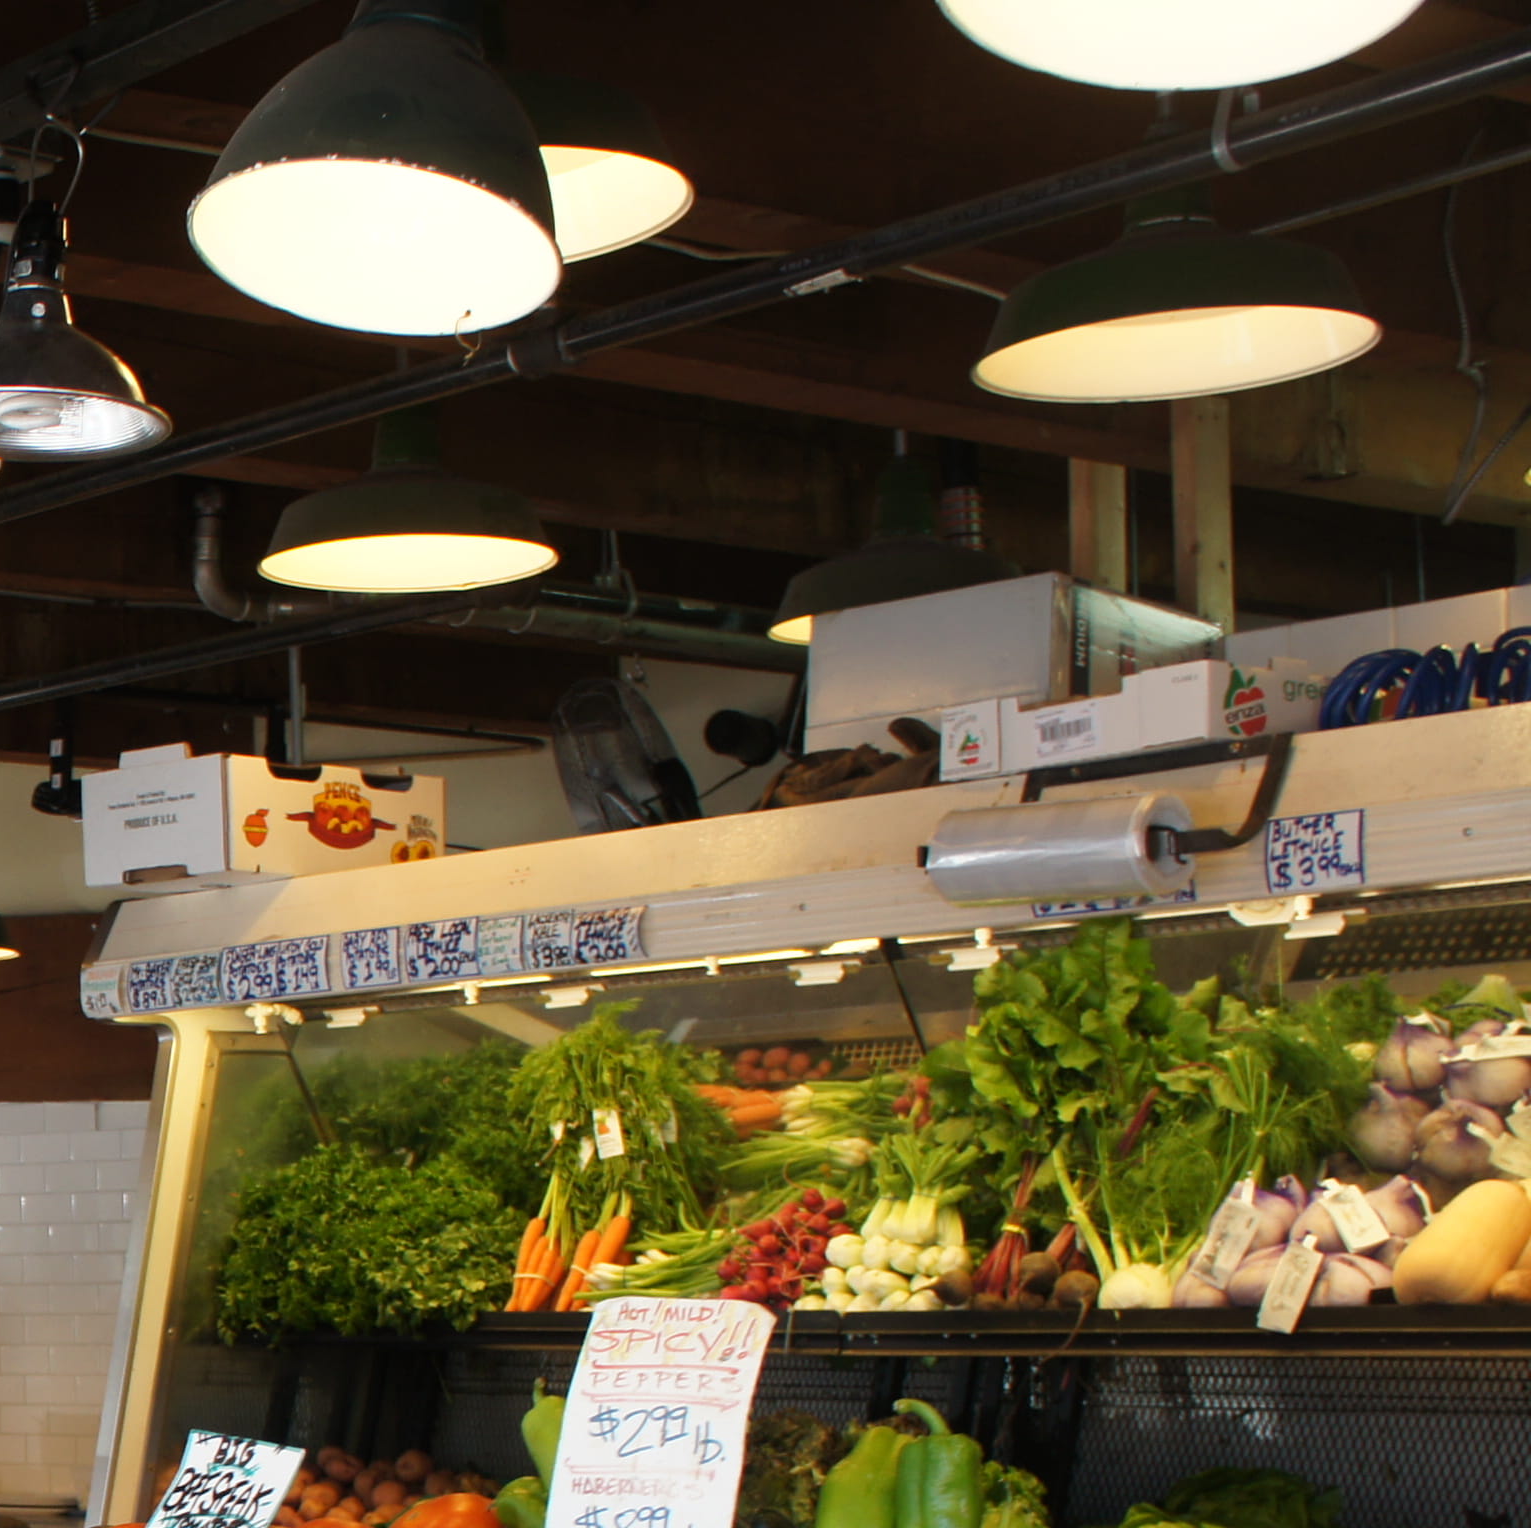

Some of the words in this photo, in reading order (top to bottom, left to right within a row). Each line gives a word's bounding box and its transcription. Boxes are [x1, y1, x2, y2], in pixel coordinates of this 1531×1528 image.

[1272, 813, 1335, 843] BUTTER
[1270, 831, 1344, 861] LETTUCE
[590, 1370, 744, 1395] PEPPERS
